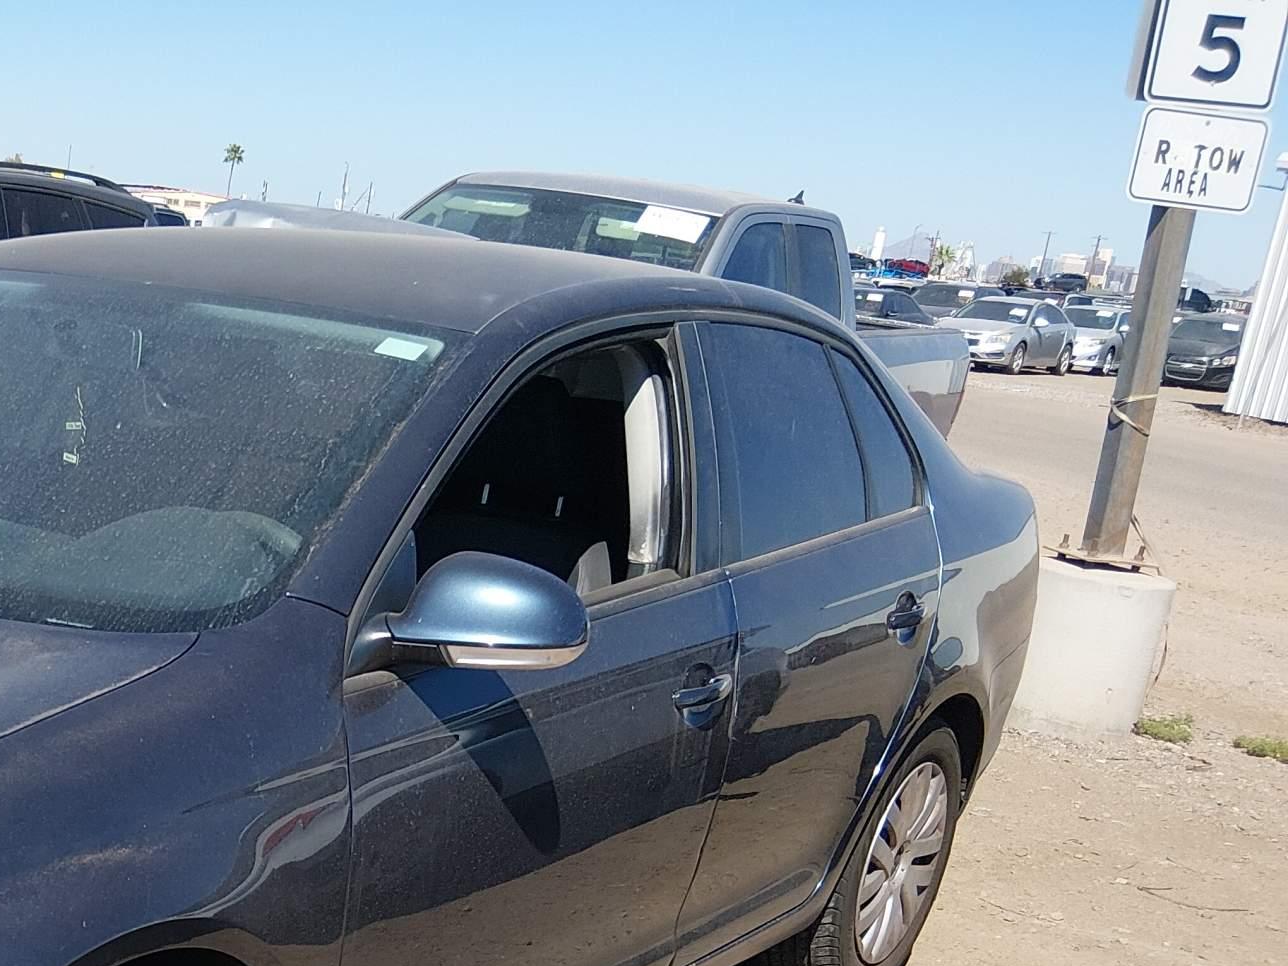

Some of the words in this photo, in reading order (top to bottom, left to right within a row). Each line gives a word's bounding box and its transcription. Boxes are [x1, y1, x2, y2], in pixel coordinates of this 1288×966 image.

[1190, 13, 1247, 85] 5
[1193, 144, 1246, 175] TOW
[1160, 167, 1209, 199] AREA
